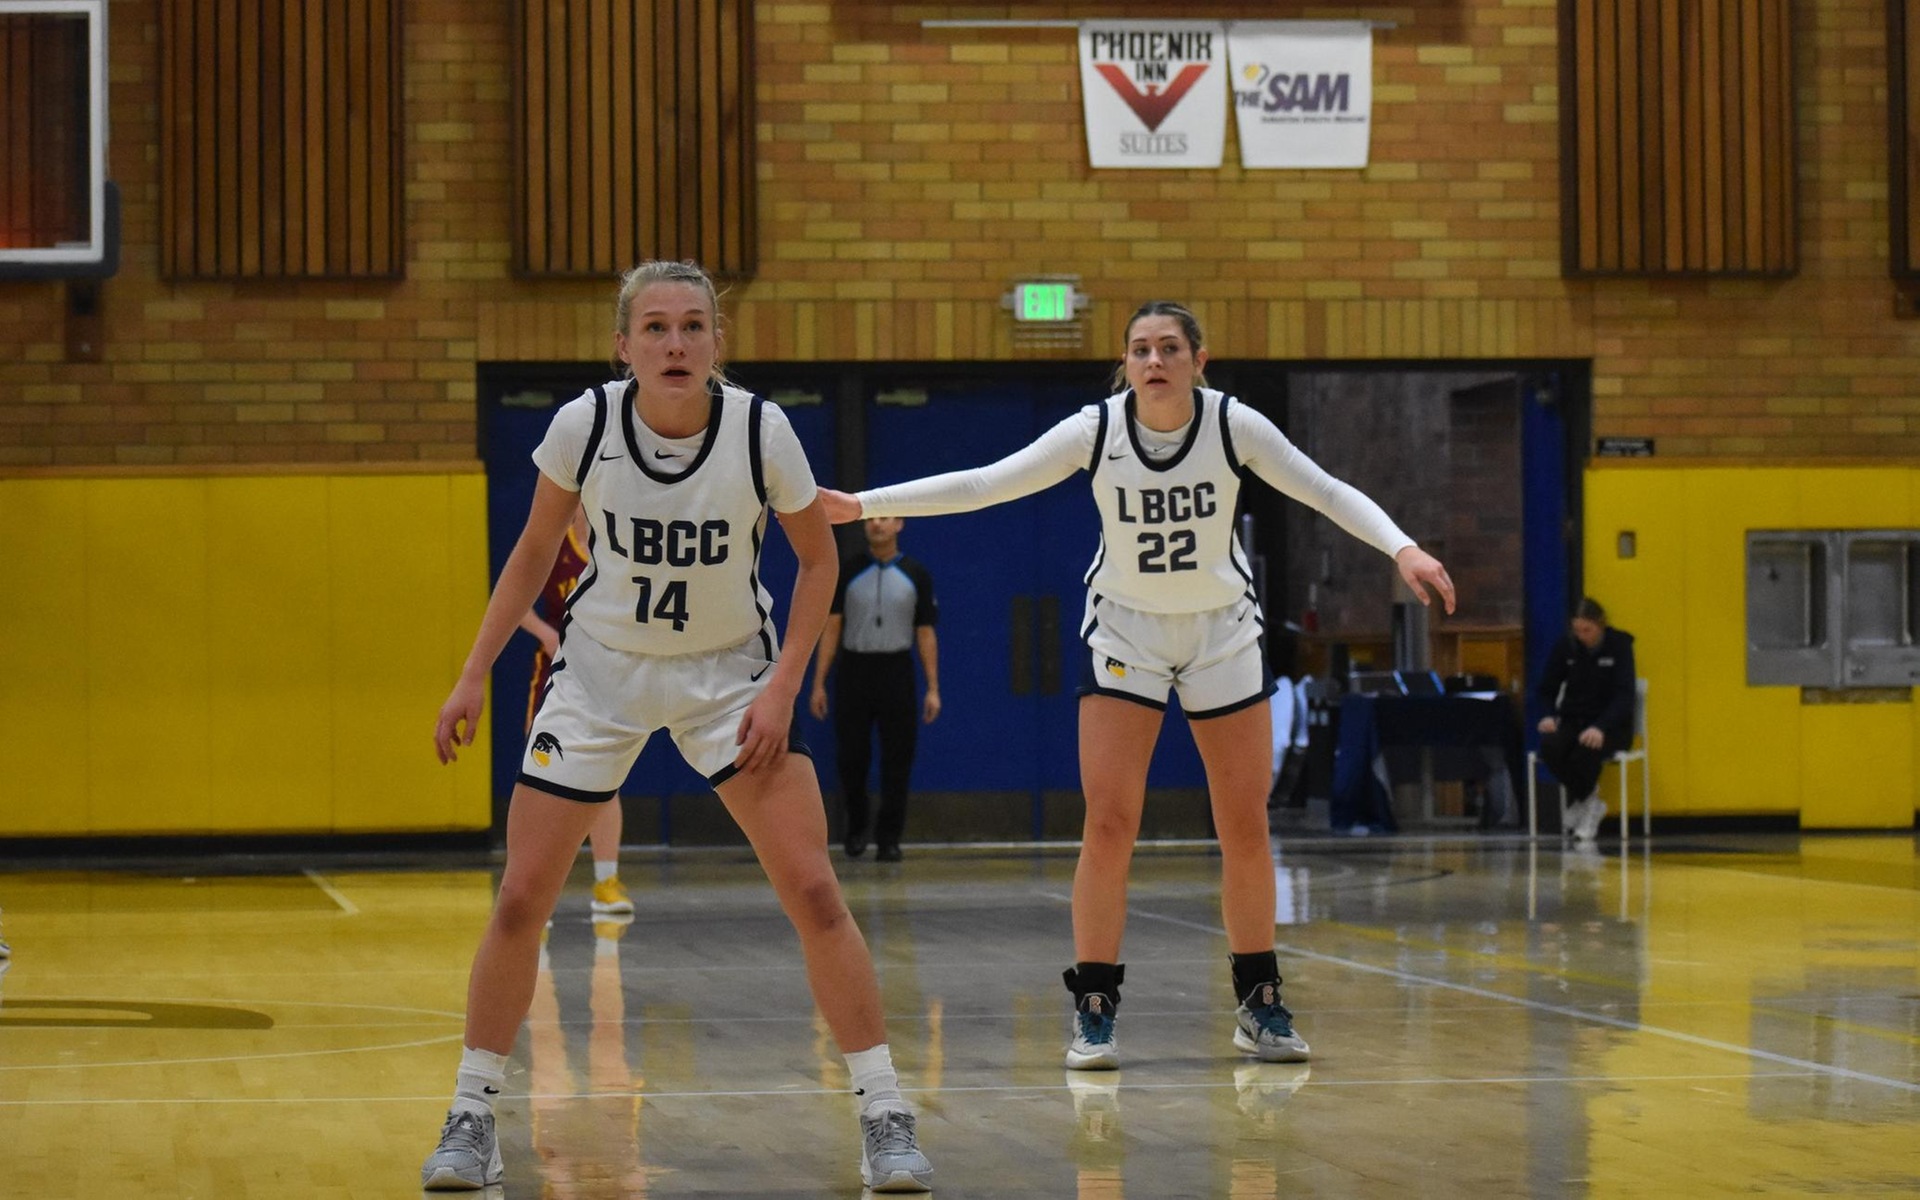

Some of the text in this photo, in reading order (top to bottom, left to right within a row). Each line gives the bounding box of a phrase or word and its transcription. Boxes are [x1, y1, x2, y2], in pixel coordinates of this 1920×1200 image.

[1092, 31, 1213, 61] PHOENIX
[1135, 62, 1168, 81] INN
[1263, 73, 1349, 112] SAM
[1119, 133, 1188, 156] SUITES
[1115, 481, 1216, 524] LBCC
[602, 509, 729, 567] LBCC
[1137, 529, 1197, 573] 22
[632, 576, 689, 632] 14
